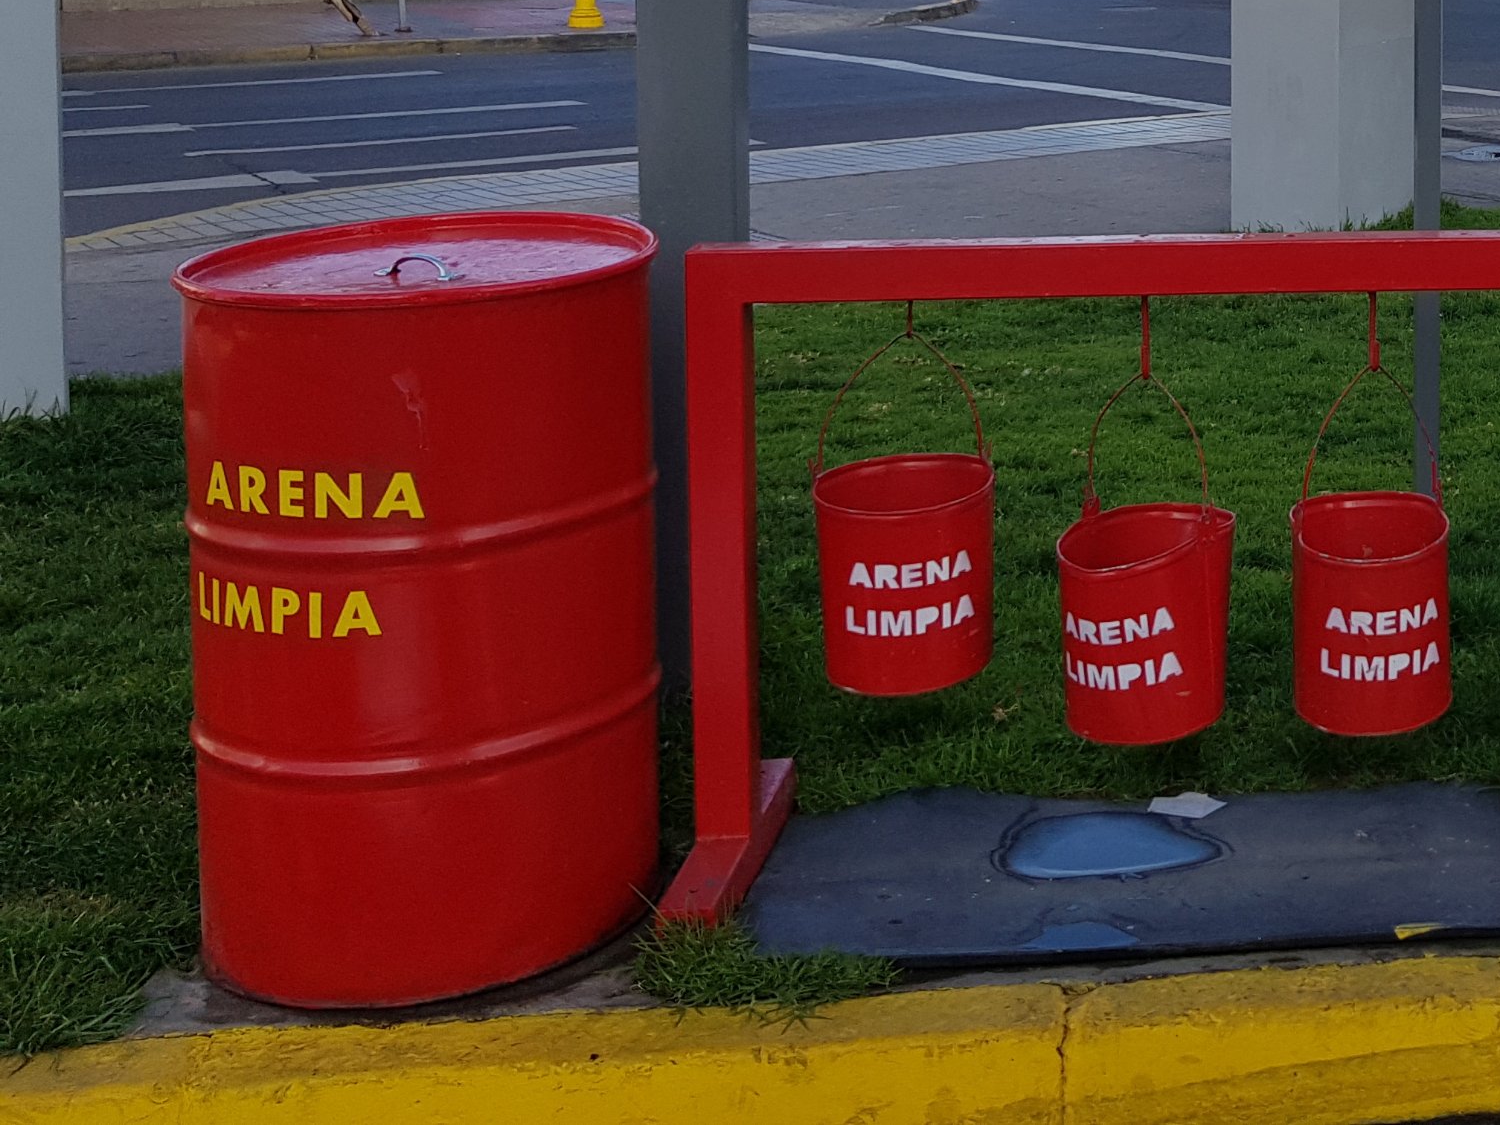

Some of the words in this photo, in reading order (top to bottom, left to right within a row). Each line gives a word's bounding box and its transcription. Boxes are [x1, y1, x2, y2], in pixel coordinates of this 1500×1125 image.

[206, 461, 426, 520] ARENA
[848, 549, 972, 590] ARENA
[199, 571, 382, 639] LIMPIA
[845, 594, 975, 638] LIMPIA
[1324, 597, 1438, 636] ARENA
[1066, 606, 1175, 646] ARENA
[1065, 650, 1184, 691] LIMPIA
[1320, 641, 1440, 681] LIMPIA
